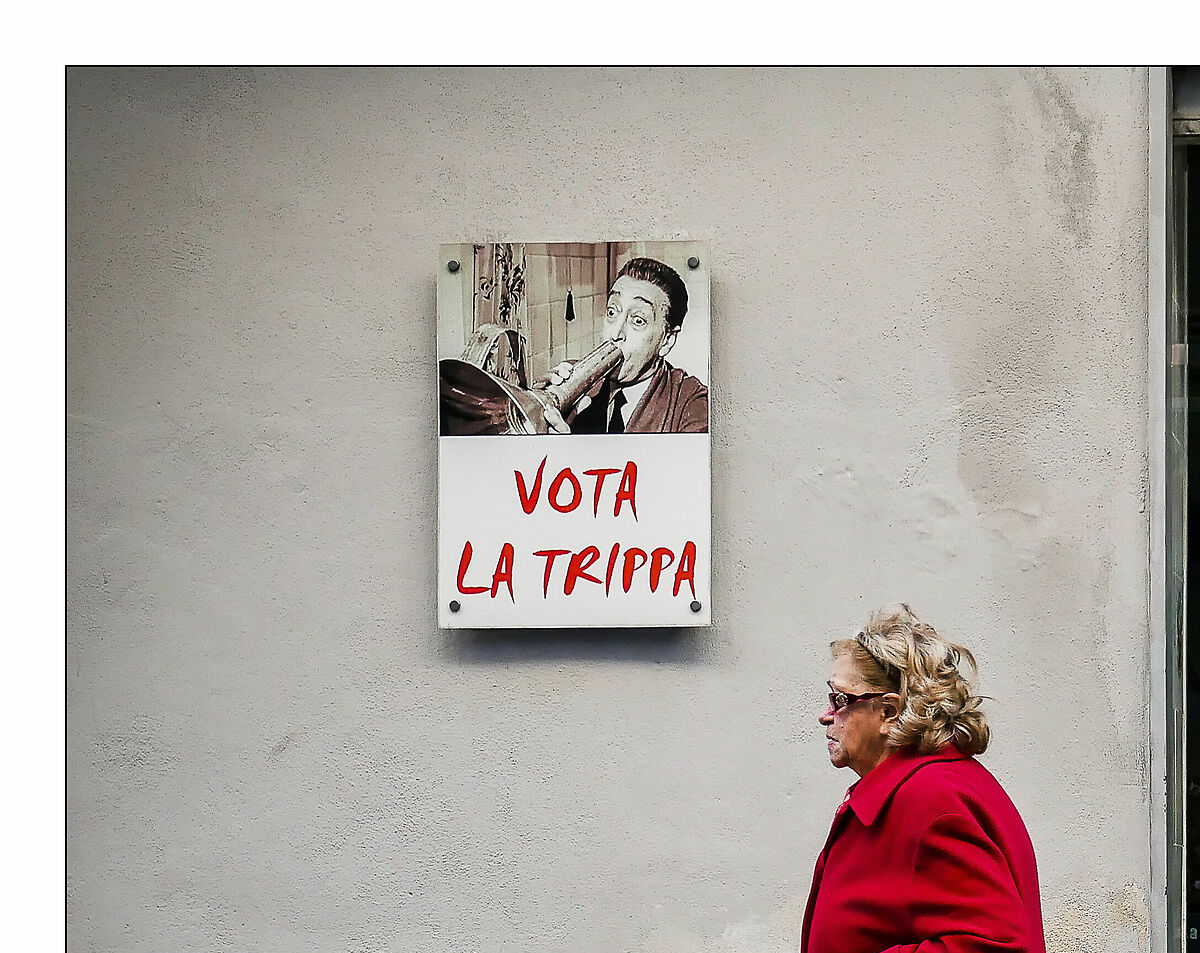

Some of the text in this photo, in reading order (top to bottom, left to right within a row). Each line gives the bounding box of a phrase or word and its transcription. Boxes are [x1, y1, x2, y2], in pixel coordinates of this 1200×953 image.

[514, 455, 638, 522] VOTA
[456, 541, 697, 603] LA TRIPPA
